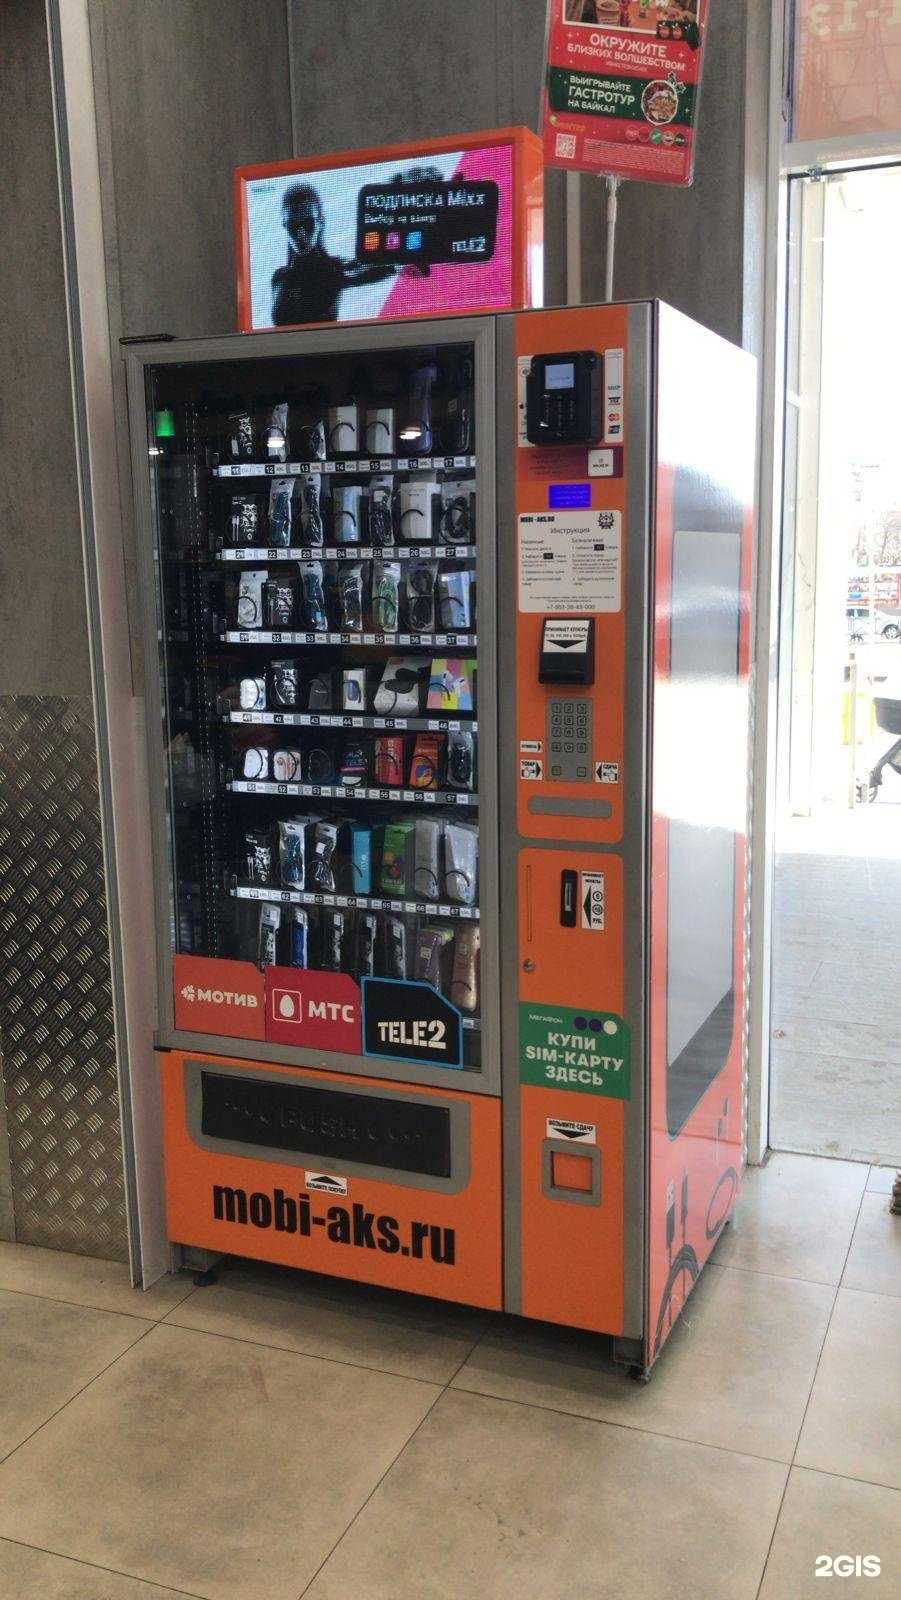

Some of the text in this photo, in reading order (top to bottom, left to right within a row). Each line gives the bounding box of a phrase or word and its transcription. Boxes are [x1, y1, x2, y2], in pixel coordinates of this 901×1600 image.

[590, 33, 667, 58] ОКРУЖИТЕ
[567, 43, 612, 60] БЛИЗКИХ
[614, 50, 686, 71] ВОЛШЕБСТВОМ
[569, 75, 632, 92] ВЫИГРЫВАЙТЕ
[569, 86, 636, 106] ГАСТРОТУР
[567, 99, 616, 114] НА БАЙКАЛ
[452, 236, 486, 253] TELE2
[265, 465, 274, 473] 12
[336, 463, 344, 471] 14
[370, 462, 380, 470] 15
[445, 458, 454, 466] 17
[550, 527, 590, 536] Инструкция
[268, 550, 276, 558] 22
[302, 550, 311, 558] 23
[337, 550, 346, 558] 24
[446, 548, 454, 556] 27
[272, 634, 281, 642] 32
[375, 635, 384, 643] 35
[281, 892, 290, 900] 62
[197, 987, 258, 1009] МОТИВ
[308, 1000, 354, 1023] МТС
[377, 1019, 447, 1050] TELE2
[547, 1032, 597, 1051] КУПИ
[525, 1045, 624, 1072] SIM-КАРТУ
[545, 1065, 604, 1086] ЗДЕСЬ
[548, 1119, 594, 1132] ВОЗЬМИТЕ СДАЧУ
[212, 1184, 456, 1266] mobi-aks.ru
